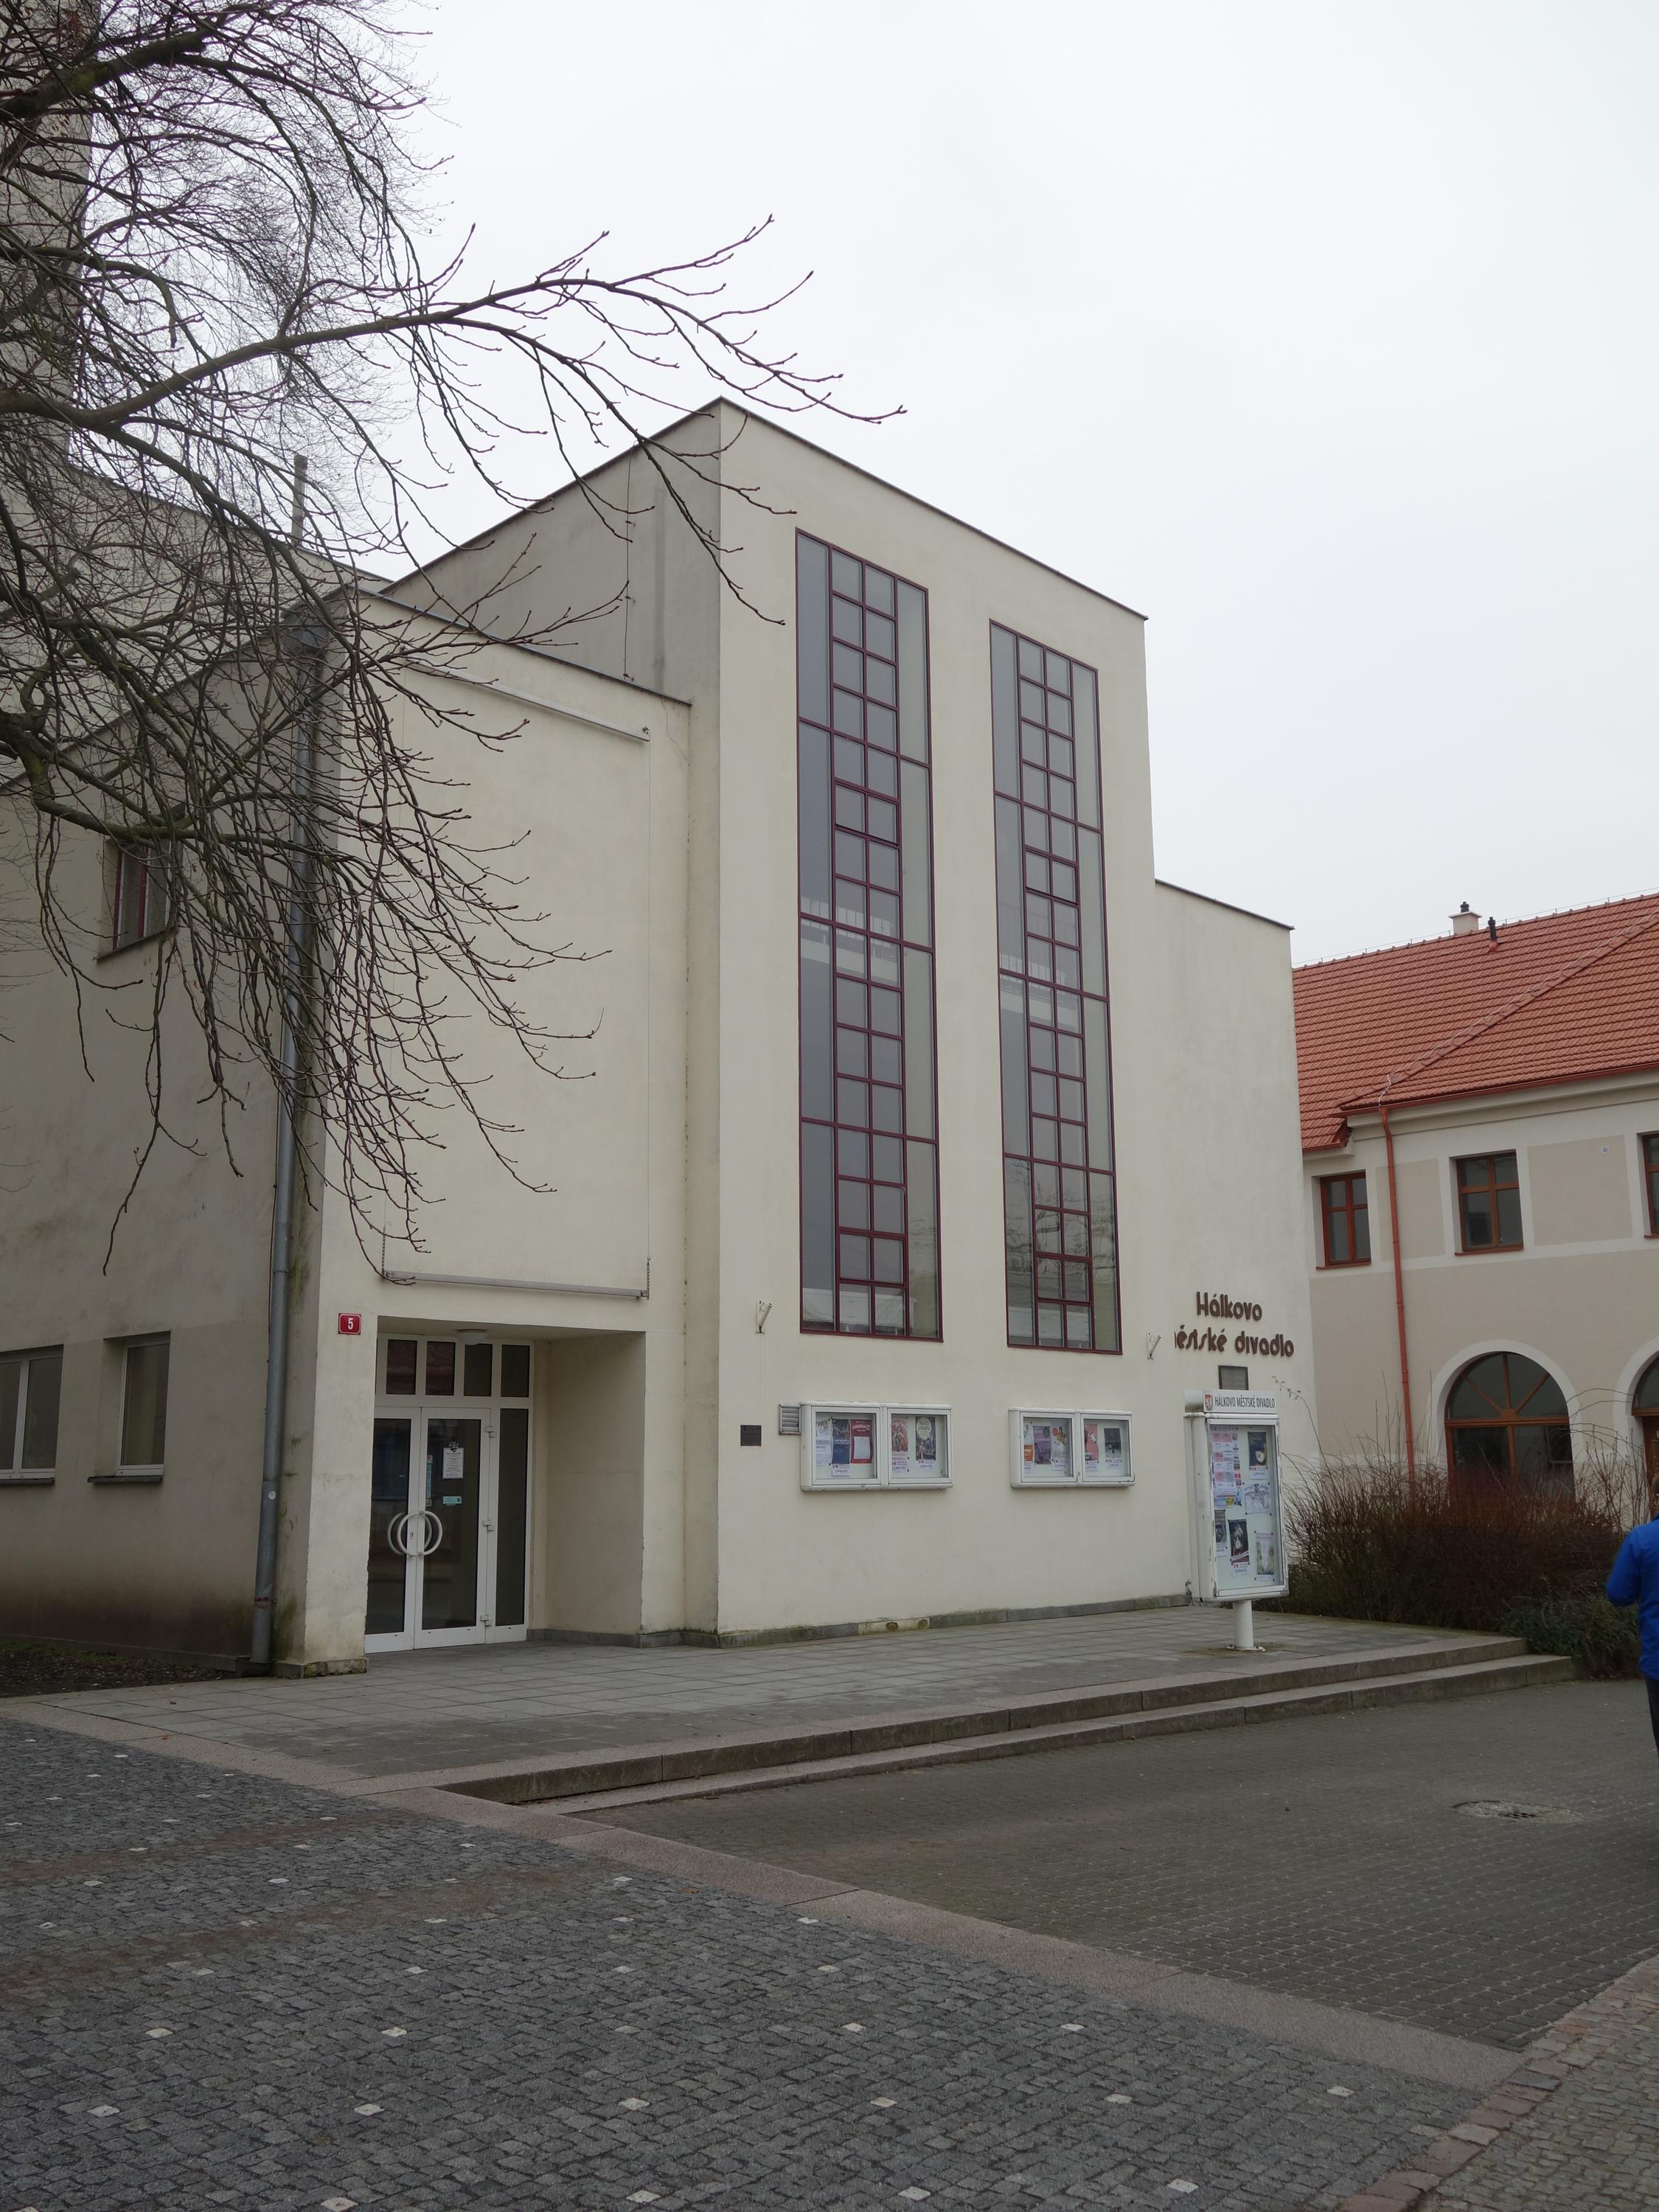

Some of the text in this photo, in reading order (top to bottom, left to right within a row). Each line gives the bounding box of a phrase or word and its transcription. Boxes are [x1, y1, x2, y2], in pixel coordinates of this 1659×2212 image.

[1196, 1291, 1262, 1321] Hálkovo
[347, 1317, 354, 1330] 5
[1174, 1324, 1295, 1357] ěstské divadlo
[1214, 1394, 1276, 1409] HÁLKOVO MĚSTSKÉ DIVADLO
